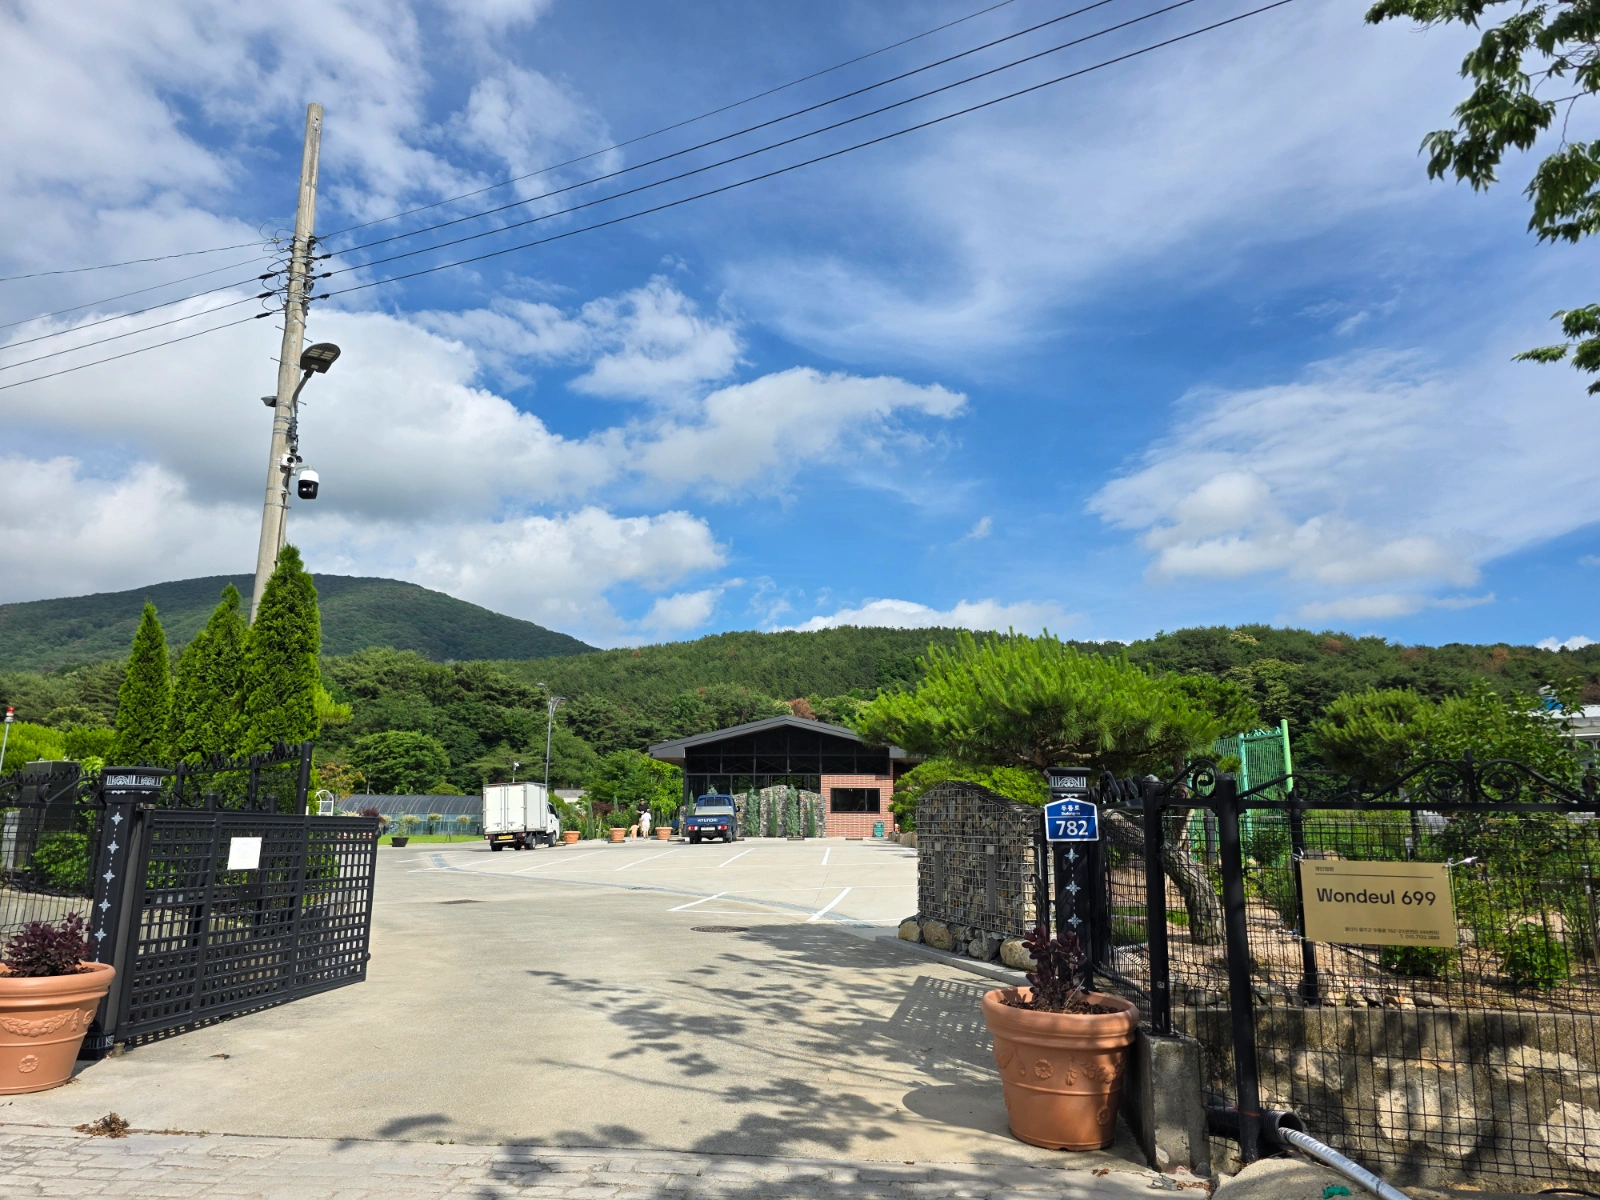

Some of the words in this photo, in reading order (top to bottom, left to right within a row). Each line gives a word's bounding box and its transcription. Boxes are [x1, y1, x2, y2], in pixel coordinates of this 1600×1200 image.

[1056, 820, 1088, 836] 782
[1316, 888, 1395, 904] Wondeul
[1401, 890, 1436, 906] 699
